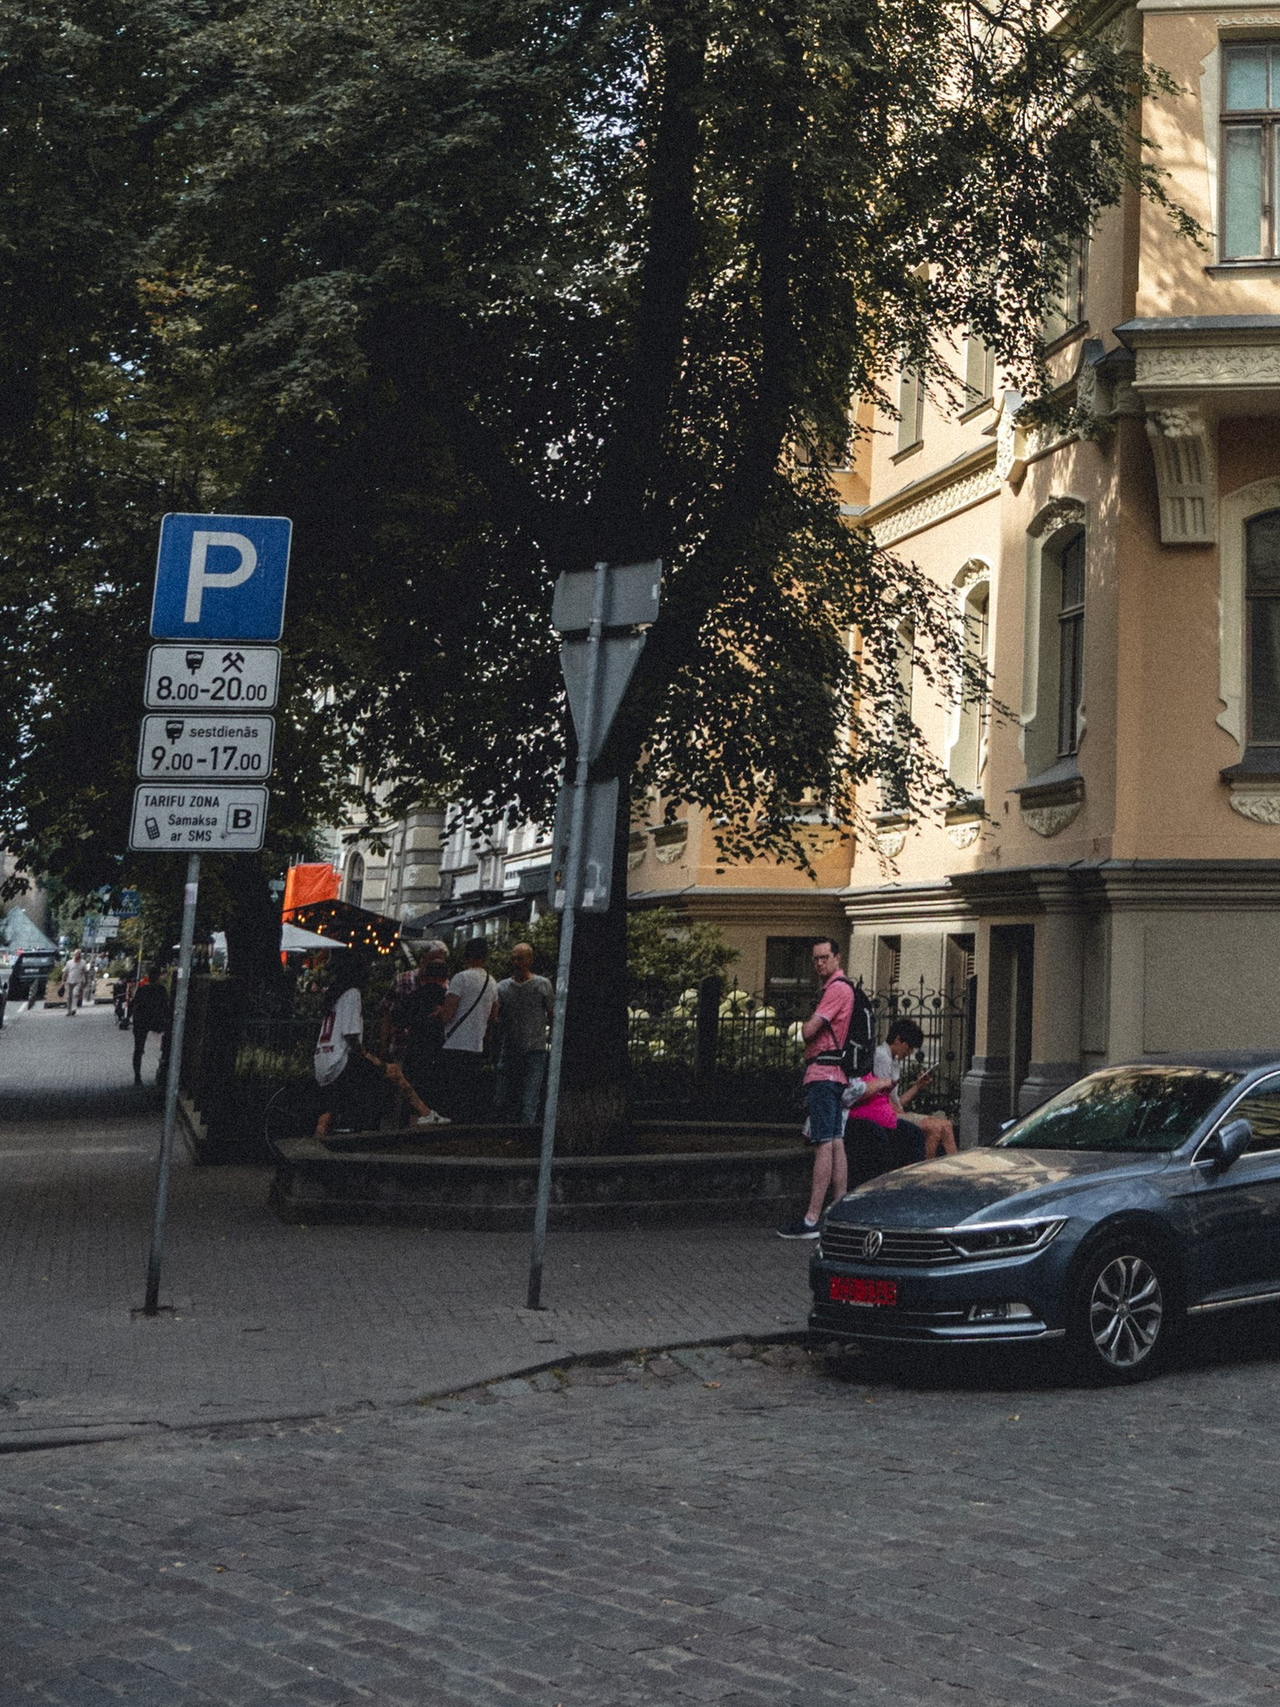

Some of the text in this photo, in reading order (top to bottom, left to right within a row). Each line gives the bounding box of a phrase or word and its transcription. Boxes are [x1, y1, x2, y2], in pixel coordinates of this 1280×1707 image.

[184, 530, 258, 623] P
[156, 676, 268, 701] 8.00-20.00
[189, 725, 259, 738] sestdienās
[144, 795, 220, 807] TARIFU ZONA
[168, 814, 218, 826] Samaksa
[232, 808, 253, 829] B
[170, 830, 212, 842] ar SMS
